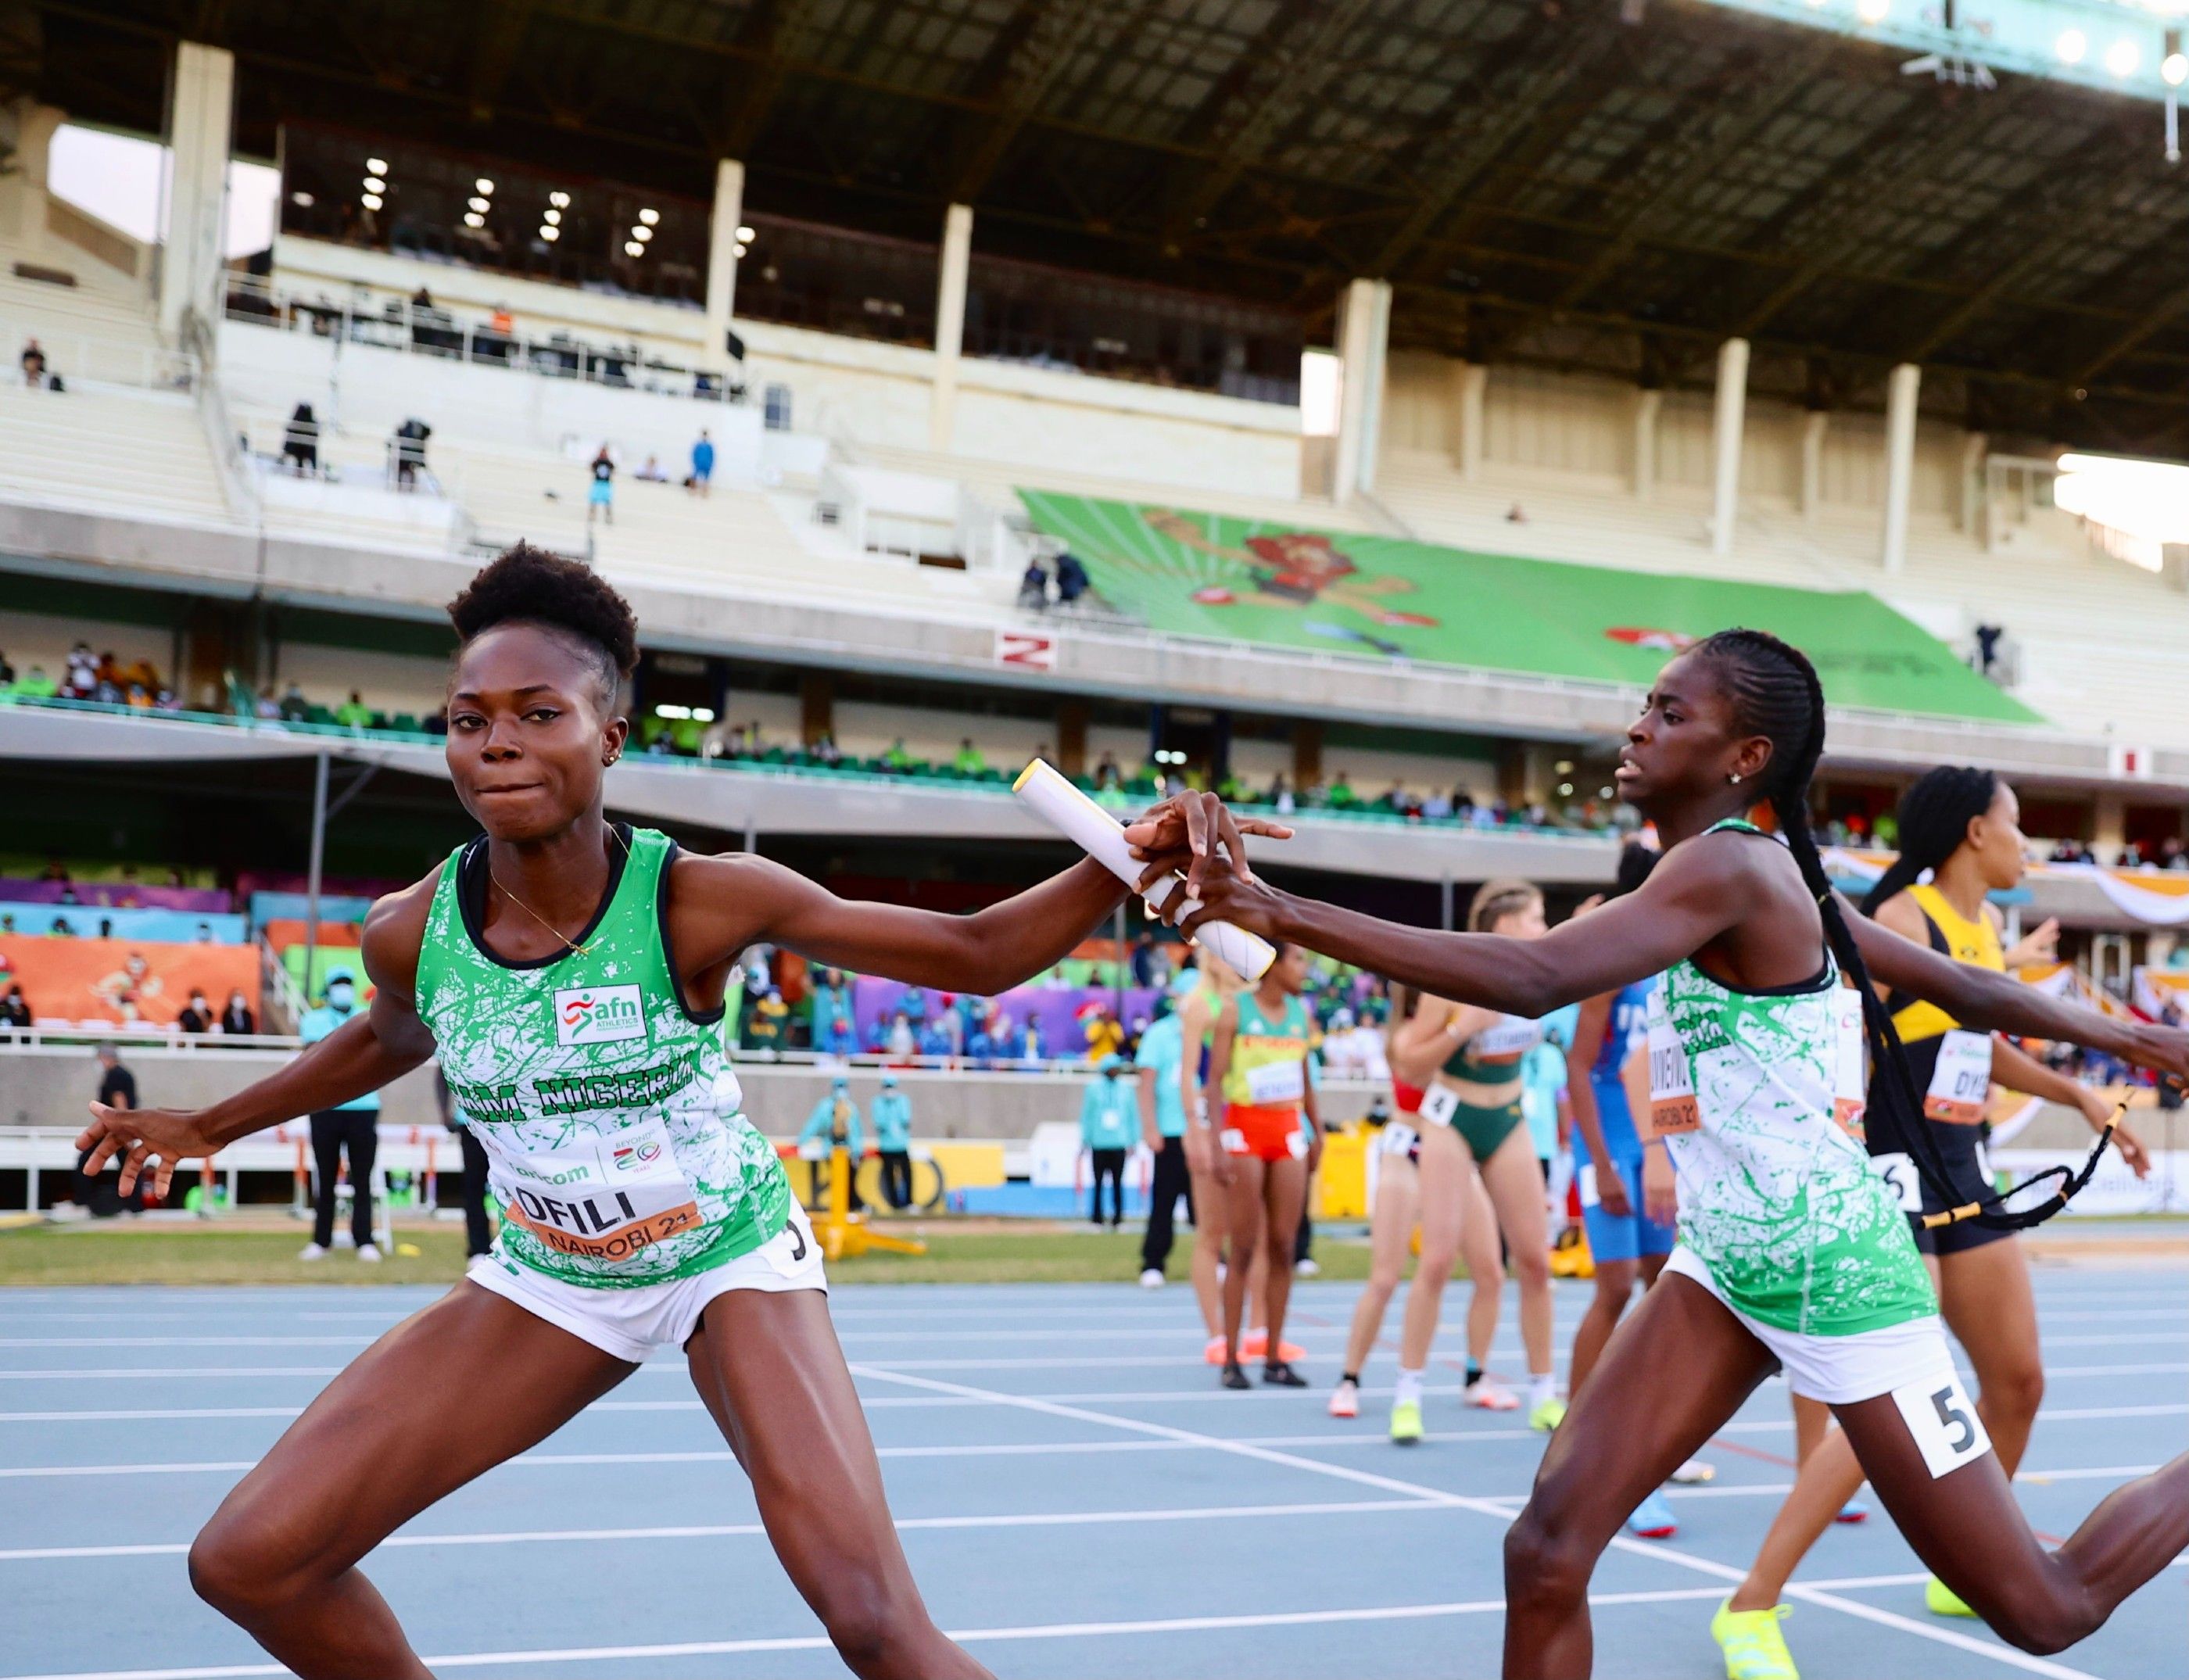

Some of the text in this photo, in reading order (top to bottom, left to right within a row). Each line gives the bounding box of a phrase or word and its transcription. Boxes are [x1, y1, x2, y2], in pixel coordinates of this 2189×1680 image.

[595, 997, 636, 1019] afn
[597, 1018, 638, 1027] ATHLETICS
[533, 1051, 693, 1116] NIGERIA
[516, 1187, 636, 1234] OFILI
[548, 1225, 653, 1258] NAIROBI
[1931, 1385, 1975, 1453] 5
